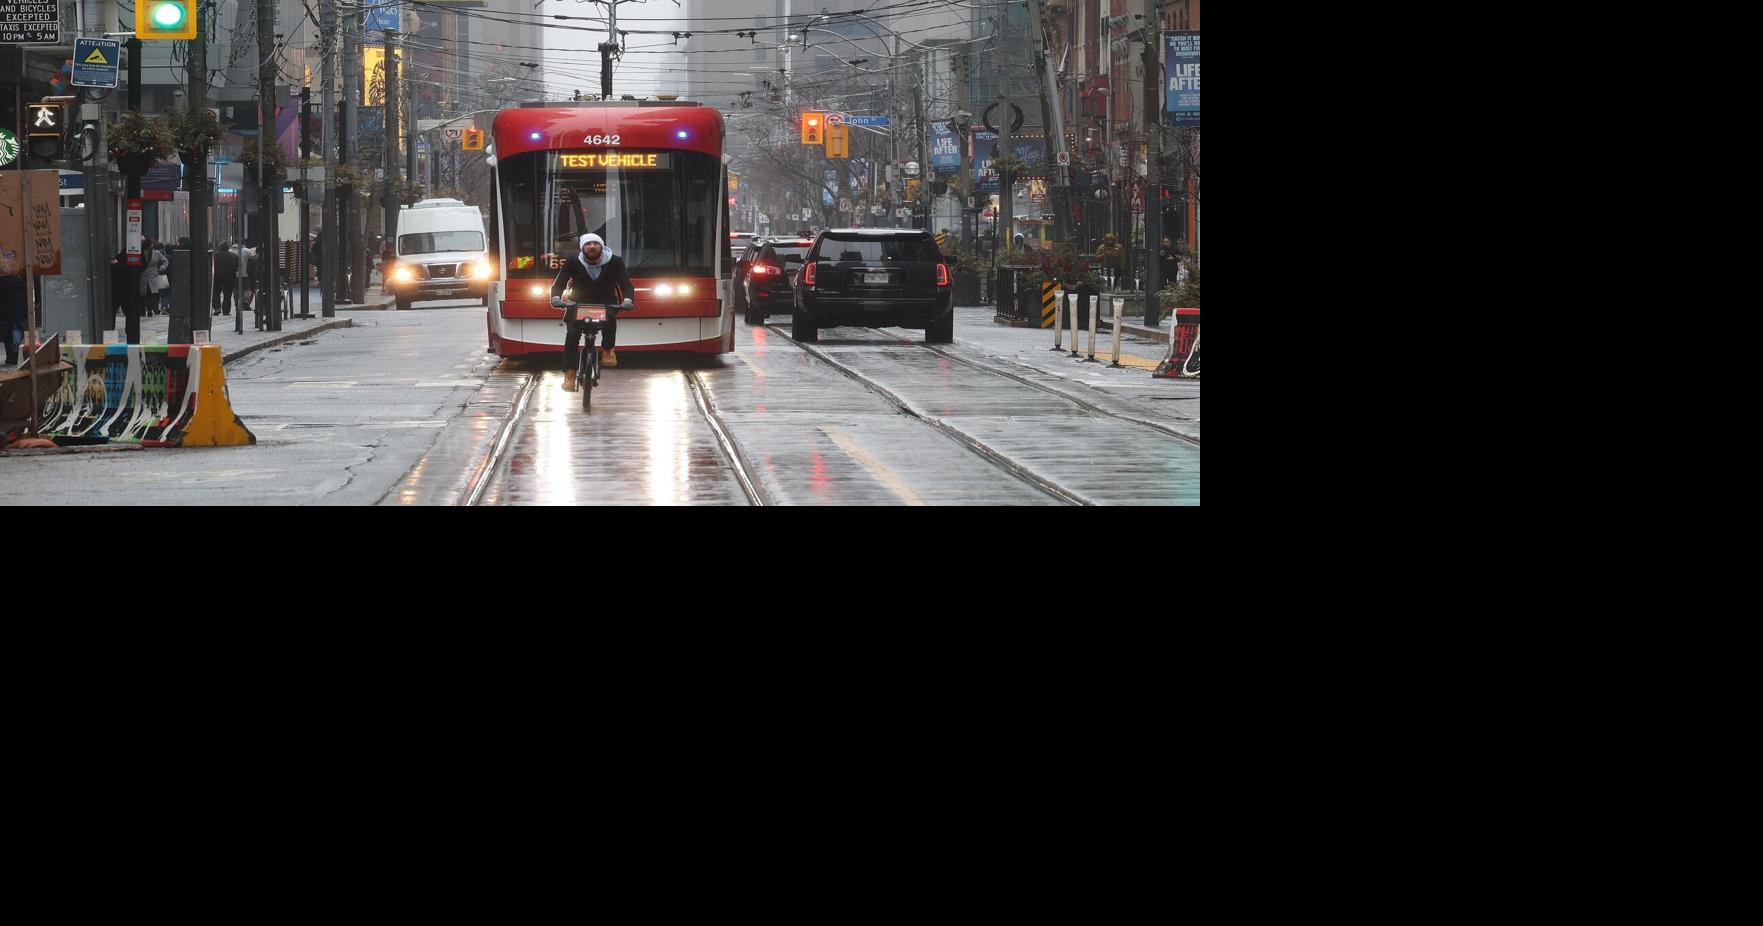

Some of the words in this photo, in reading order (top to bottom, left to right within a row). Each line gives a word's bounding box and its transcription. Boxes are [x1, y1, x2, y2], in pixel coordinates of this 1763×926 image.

[1176, 64, 1200, 77] LIFE
[584, 134, 620, 145] 4642
[937, 138, 953, 146] LIFE
[934, 146, 957, 155] AFTER
[560, 154, 596, 167] TEST
[598, 154, 657, 166] VEHICLE
